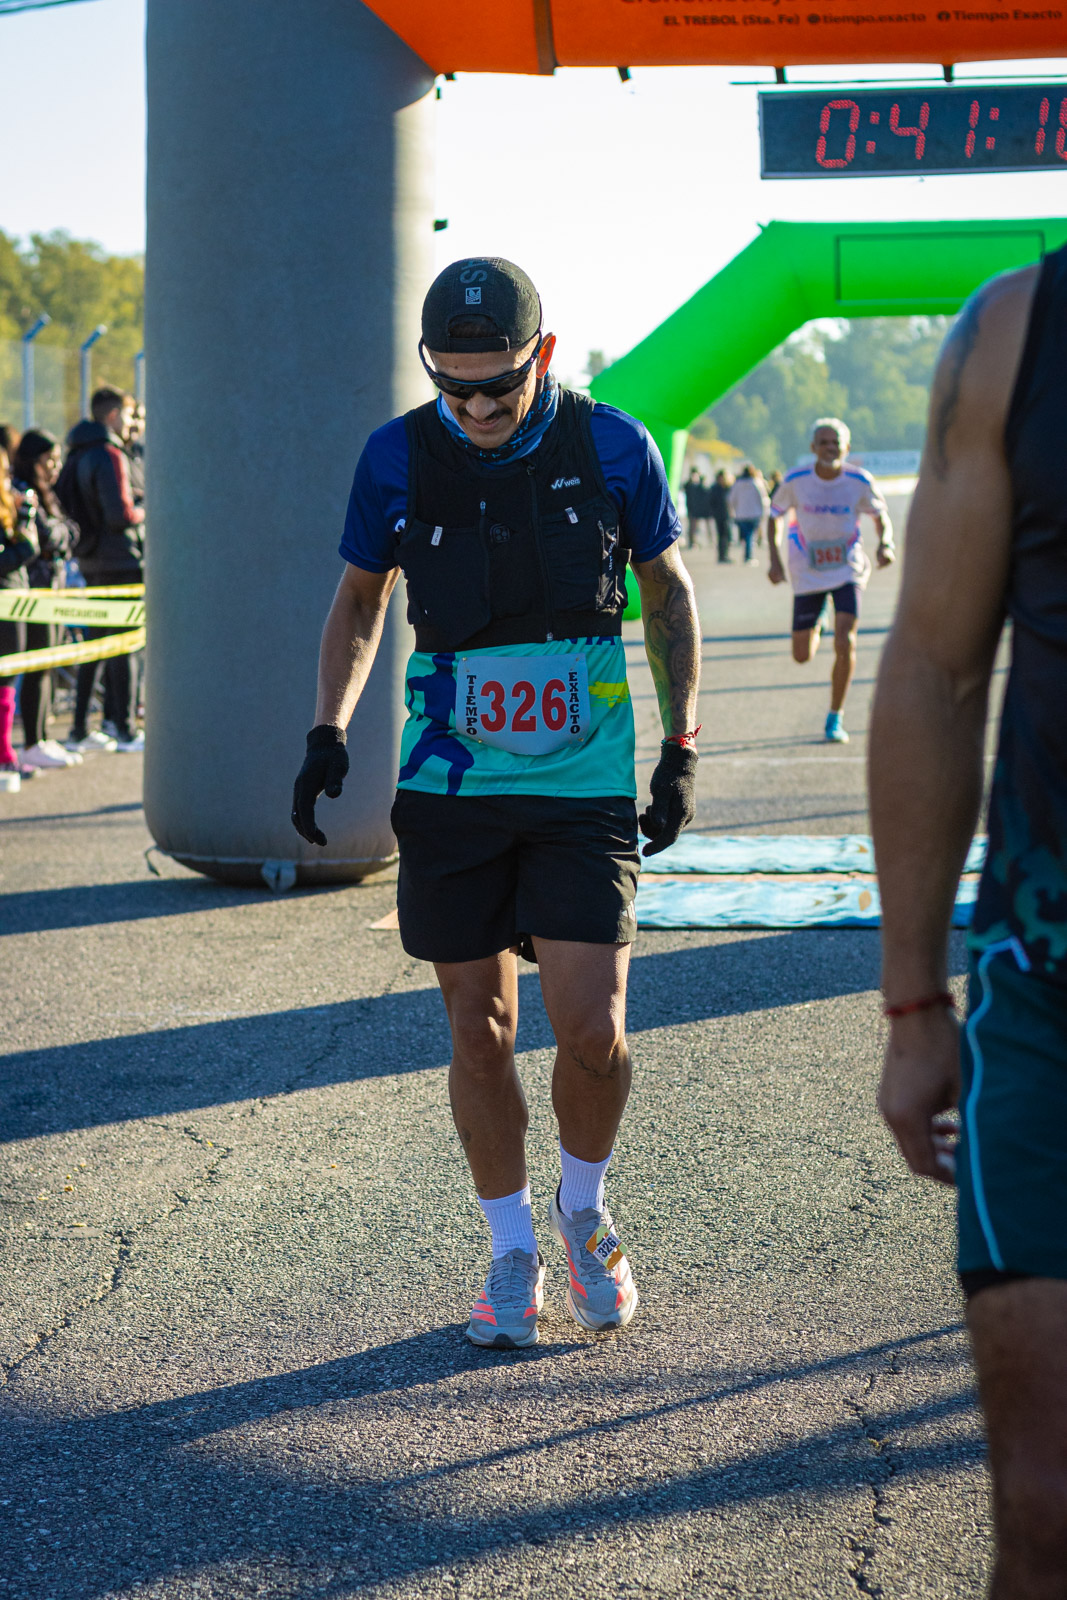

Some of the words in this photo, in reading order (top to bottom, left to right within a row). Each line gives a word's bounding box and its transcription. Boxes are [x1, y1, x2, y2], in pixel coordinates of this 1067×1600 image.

[663, 15, 680, 26] EL
[683, 14, 739, 26] TREBOL
[743, 14, 775, 26] (Sta.
[778, 13, 799, 26] Fe)
[953, 10, 1010, 22] Tiempo
[1013, 9, 1063, 20] Exacto
[465, 674, 478, 736] TIEMPO
[480, 678, 568, 732] 326
[568, 671, 581, 735] EXACTO
[597, 1237, 617, 1258] 326
